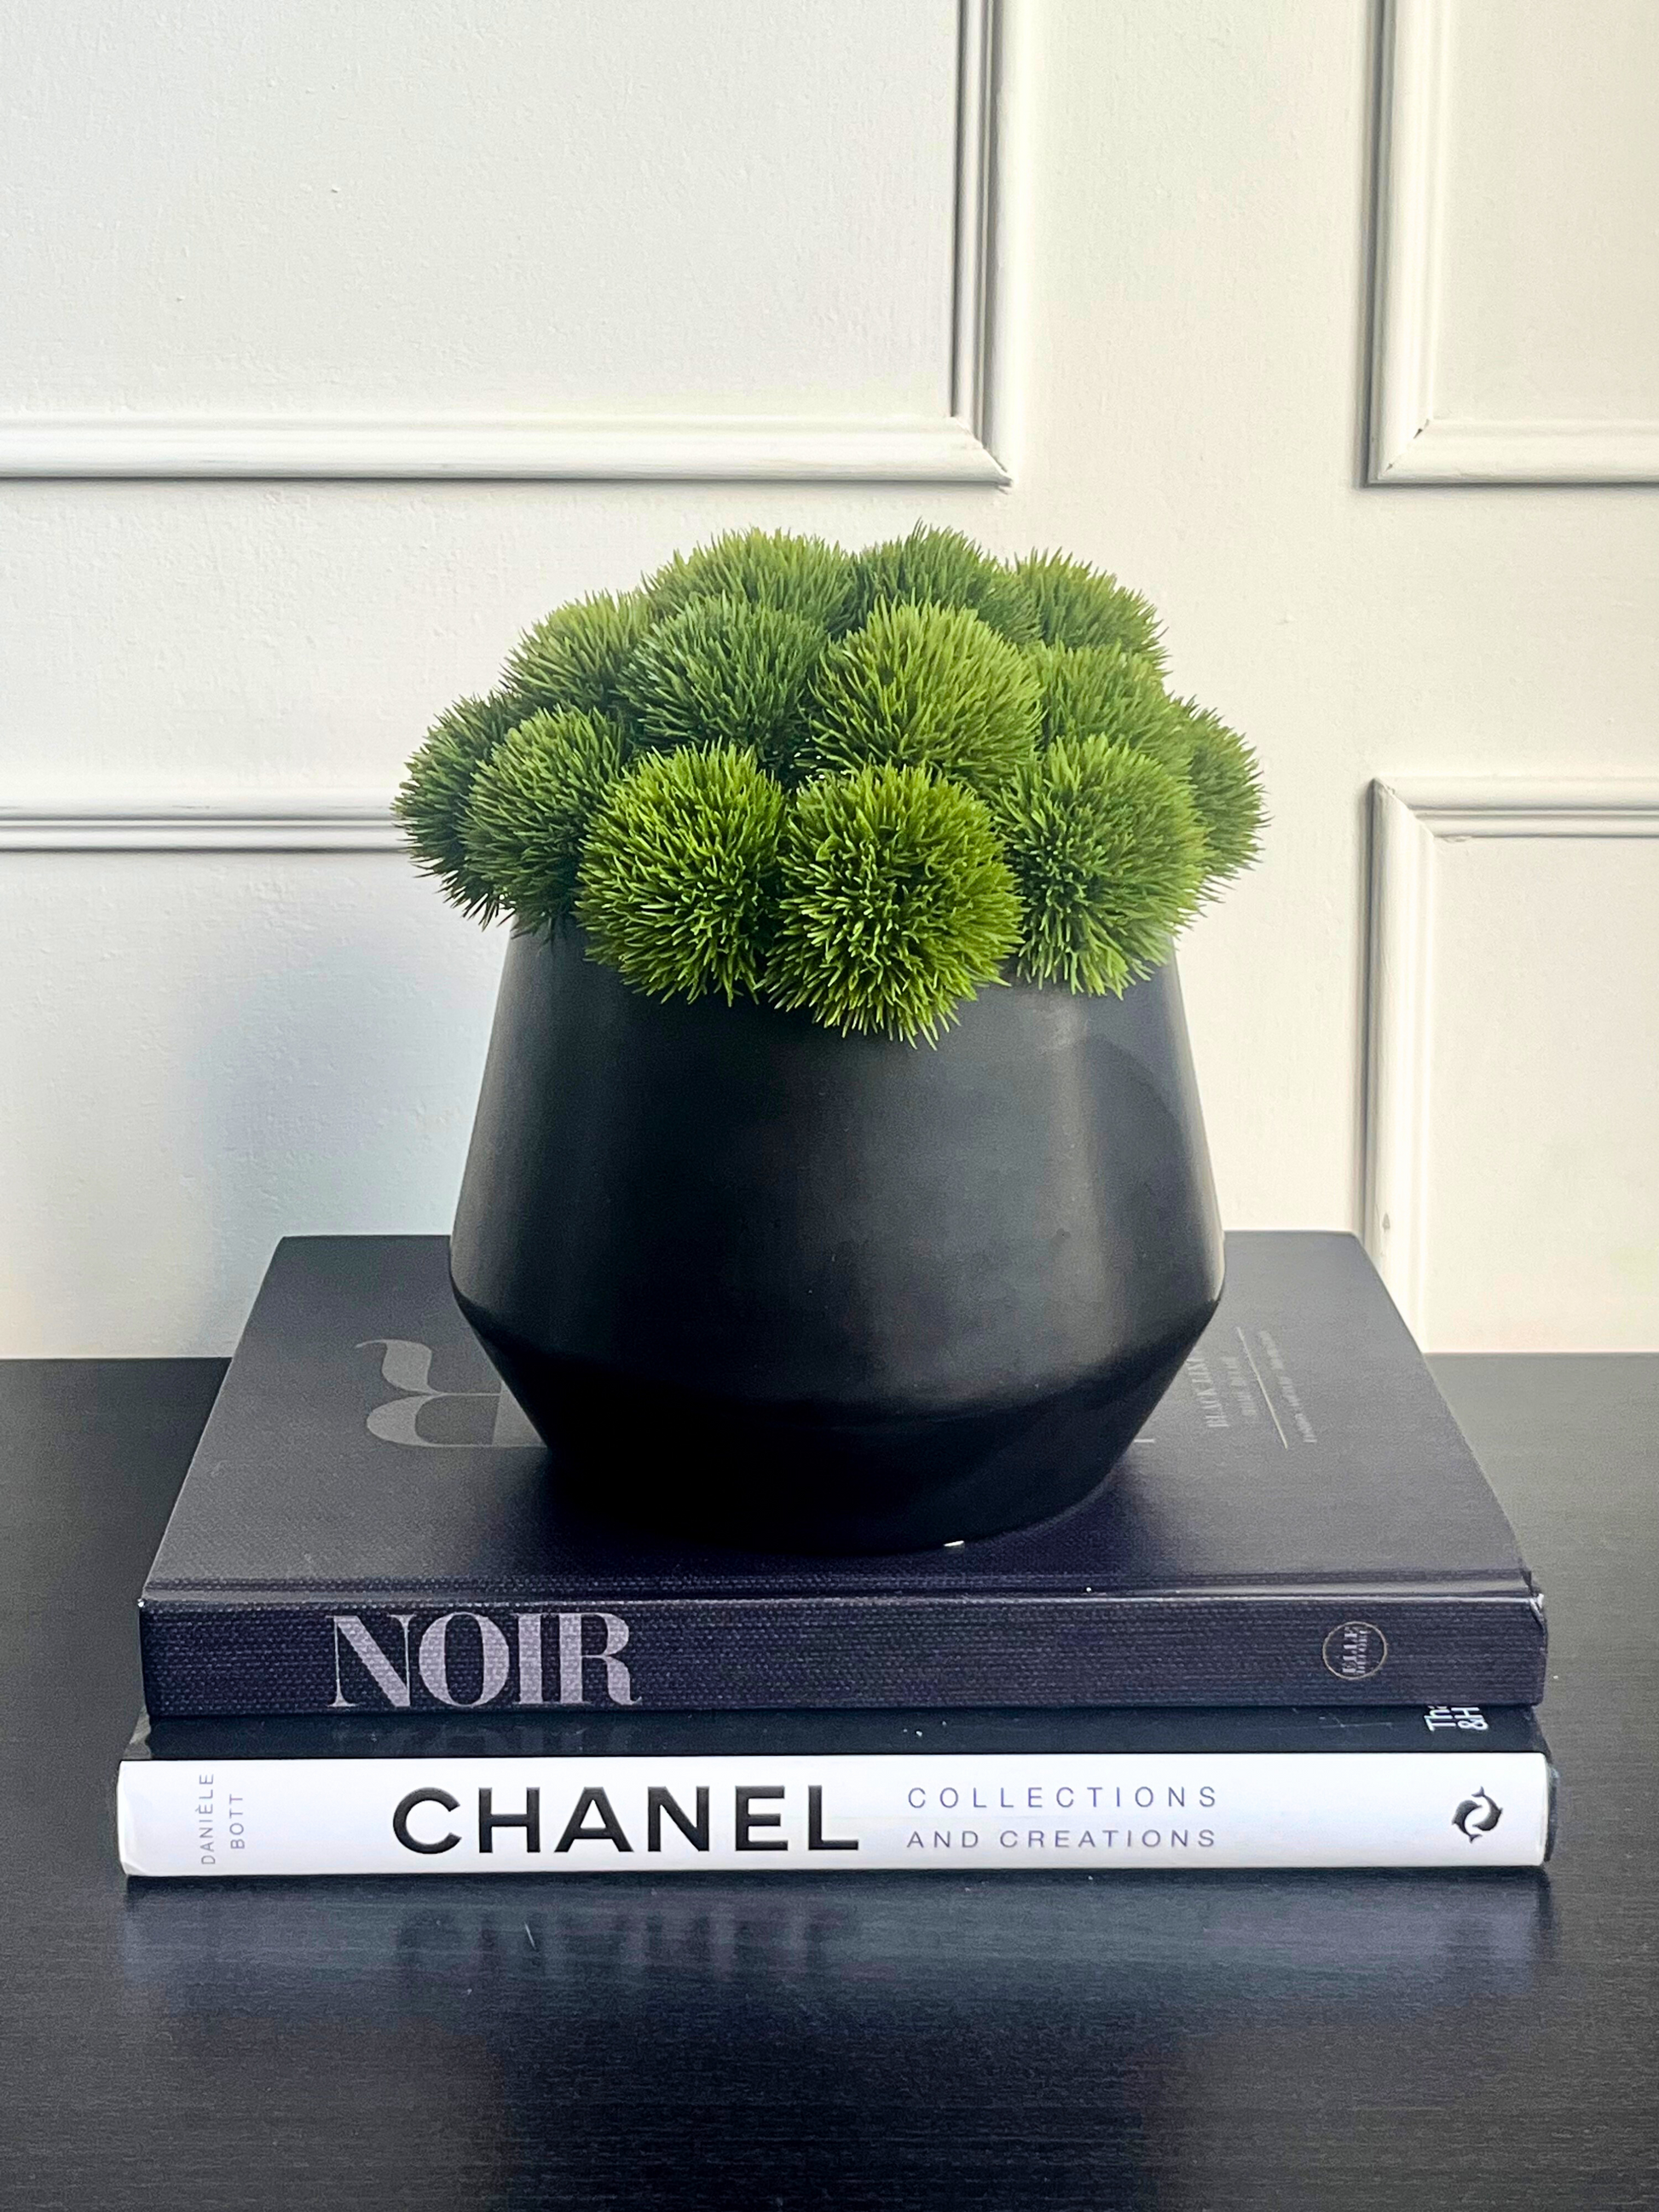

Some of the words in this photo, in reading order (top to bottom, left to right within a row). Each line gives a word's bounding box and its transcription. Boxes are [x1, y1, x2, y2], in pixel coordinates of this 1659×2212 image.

[326, 1611, 642, 1707] NOIR
[194, 1774, 217, 1865] DANIÈLE
[228, 1793, 246, 1849] BOTT
[392, 1785, 859, 1854] CHANEL
[907, 1786, 1217, 1809] COLLECTIONS
[906, 1829, 980, 1849] AND
[999, 1828, 1216, 1849] CREATIONS
